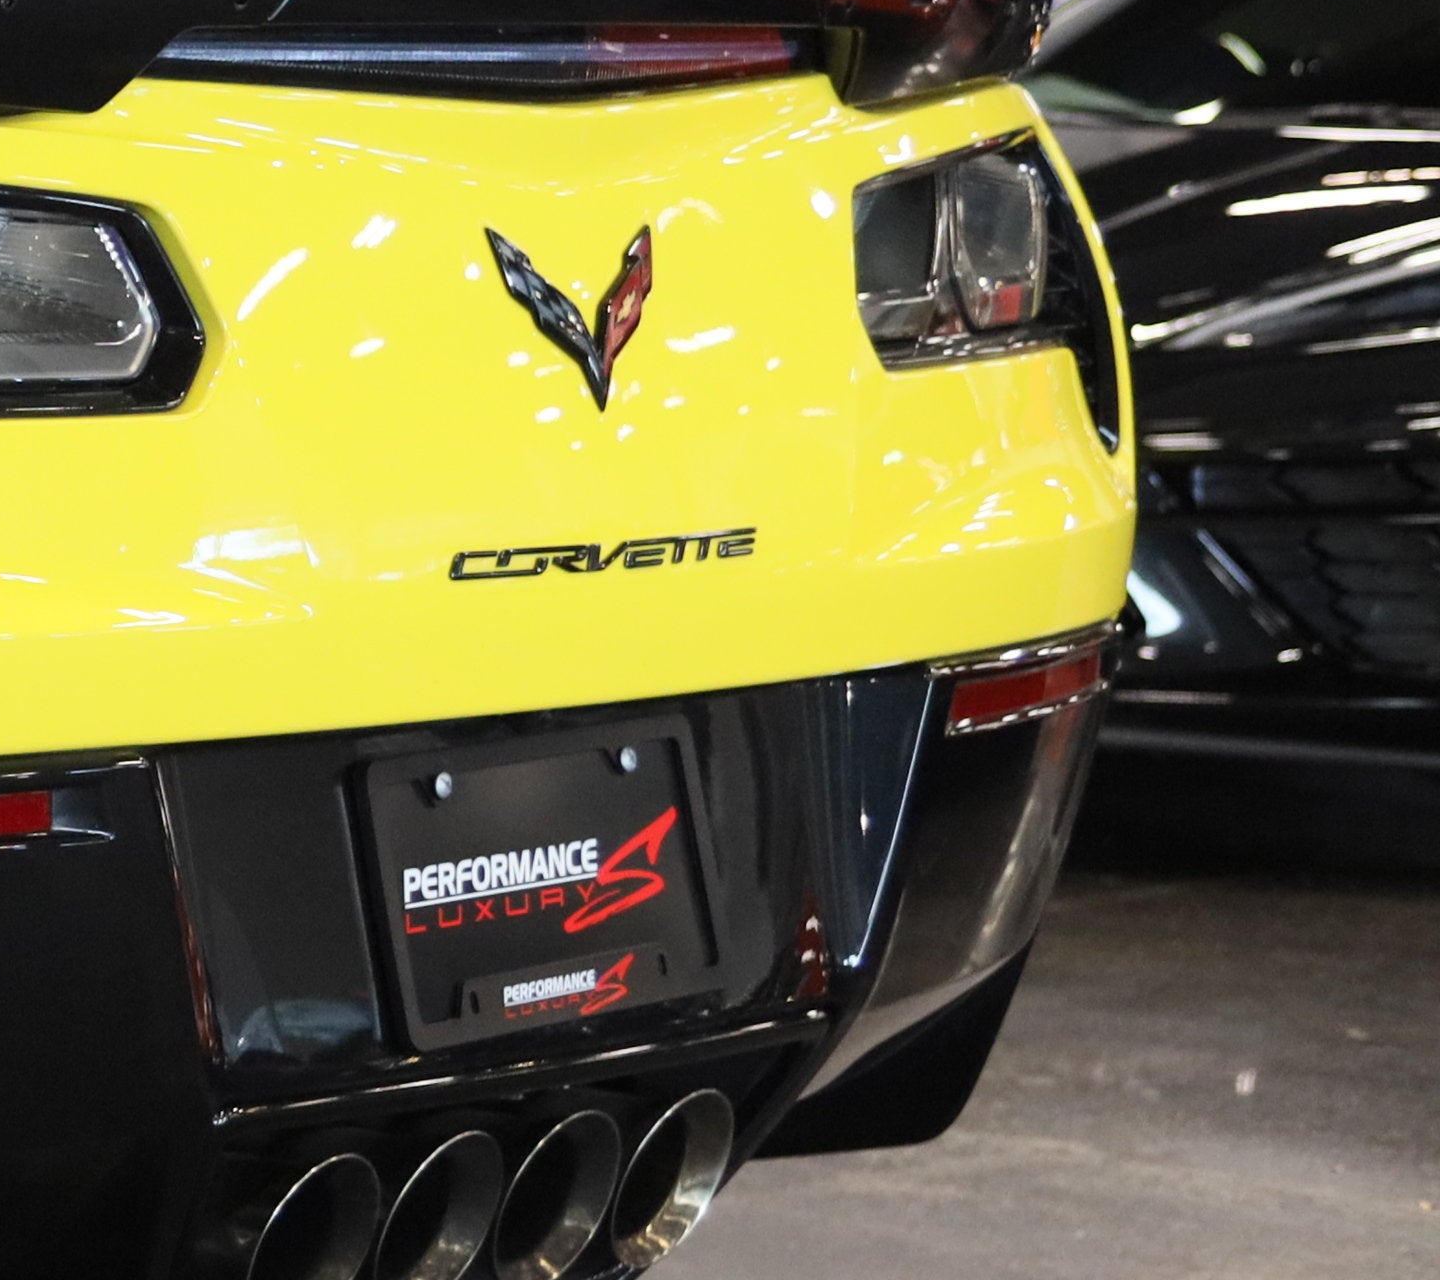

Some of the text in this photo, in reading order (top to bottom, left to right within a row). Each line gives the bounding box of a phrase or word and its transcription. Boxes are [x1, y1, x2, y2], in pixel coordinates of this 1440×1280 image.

[449, 527, 757, 581] CORVETTE
[403, 838, 599, 903] PERFORMANCE
[405, 881, 600, 934] LUXURY
[503, 968, 596, 1002] PERFORMANCE
